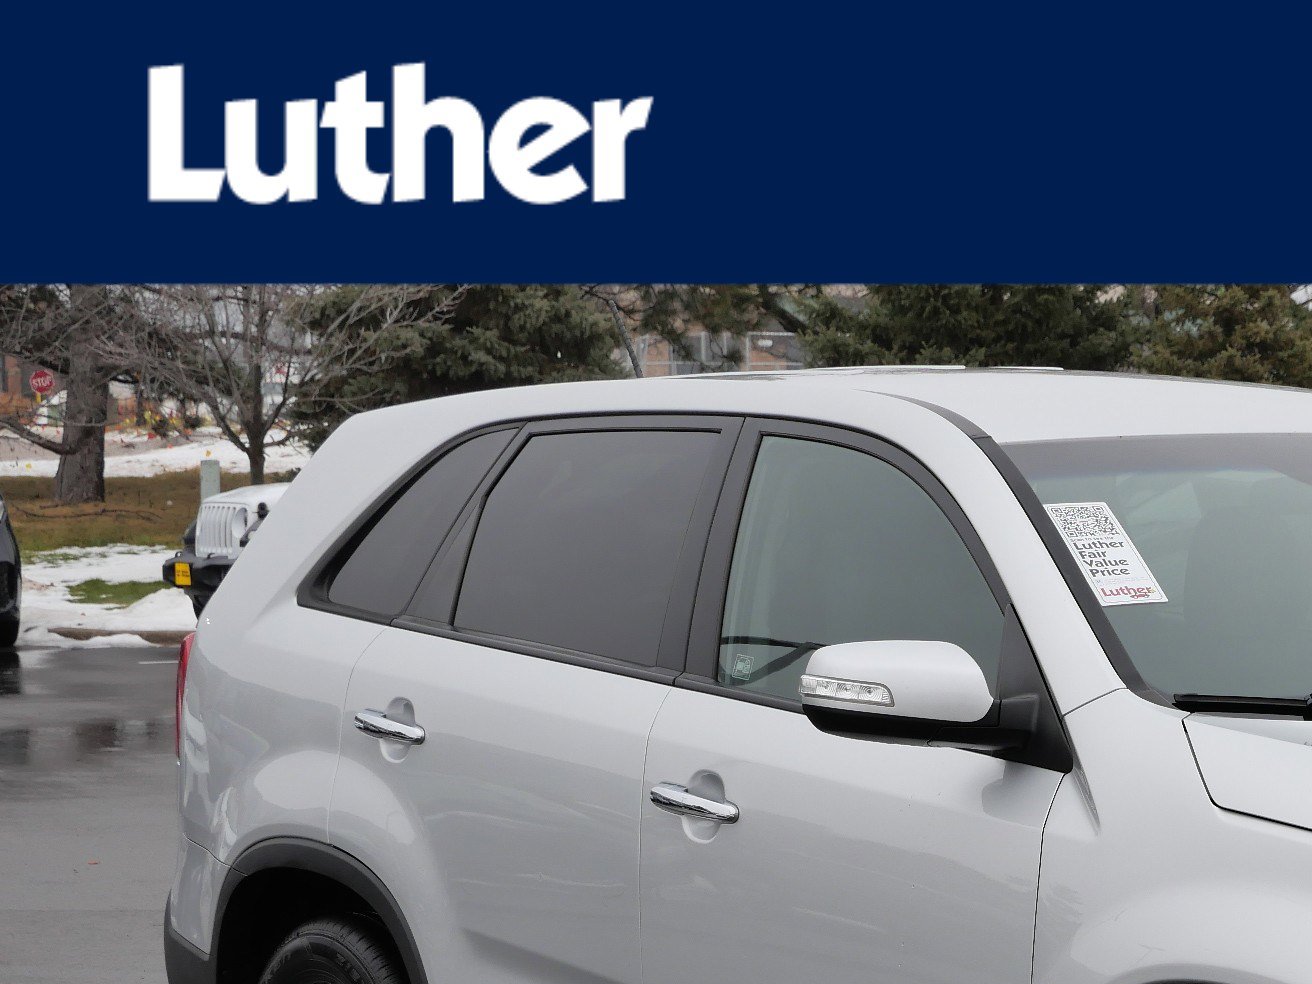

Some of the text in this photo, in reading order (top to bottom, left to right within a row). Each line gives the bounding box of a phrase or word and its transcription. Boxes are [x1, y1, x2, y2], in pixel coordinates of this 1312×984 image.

[1072, 540, 1124, 551] Luther
[1077, 549, 1107, 559] Fair
[1083, 558, 1130, 568] Value
[1089, 567, 1130, 577] Price
[1100, 585, 1153, 597] Luther
